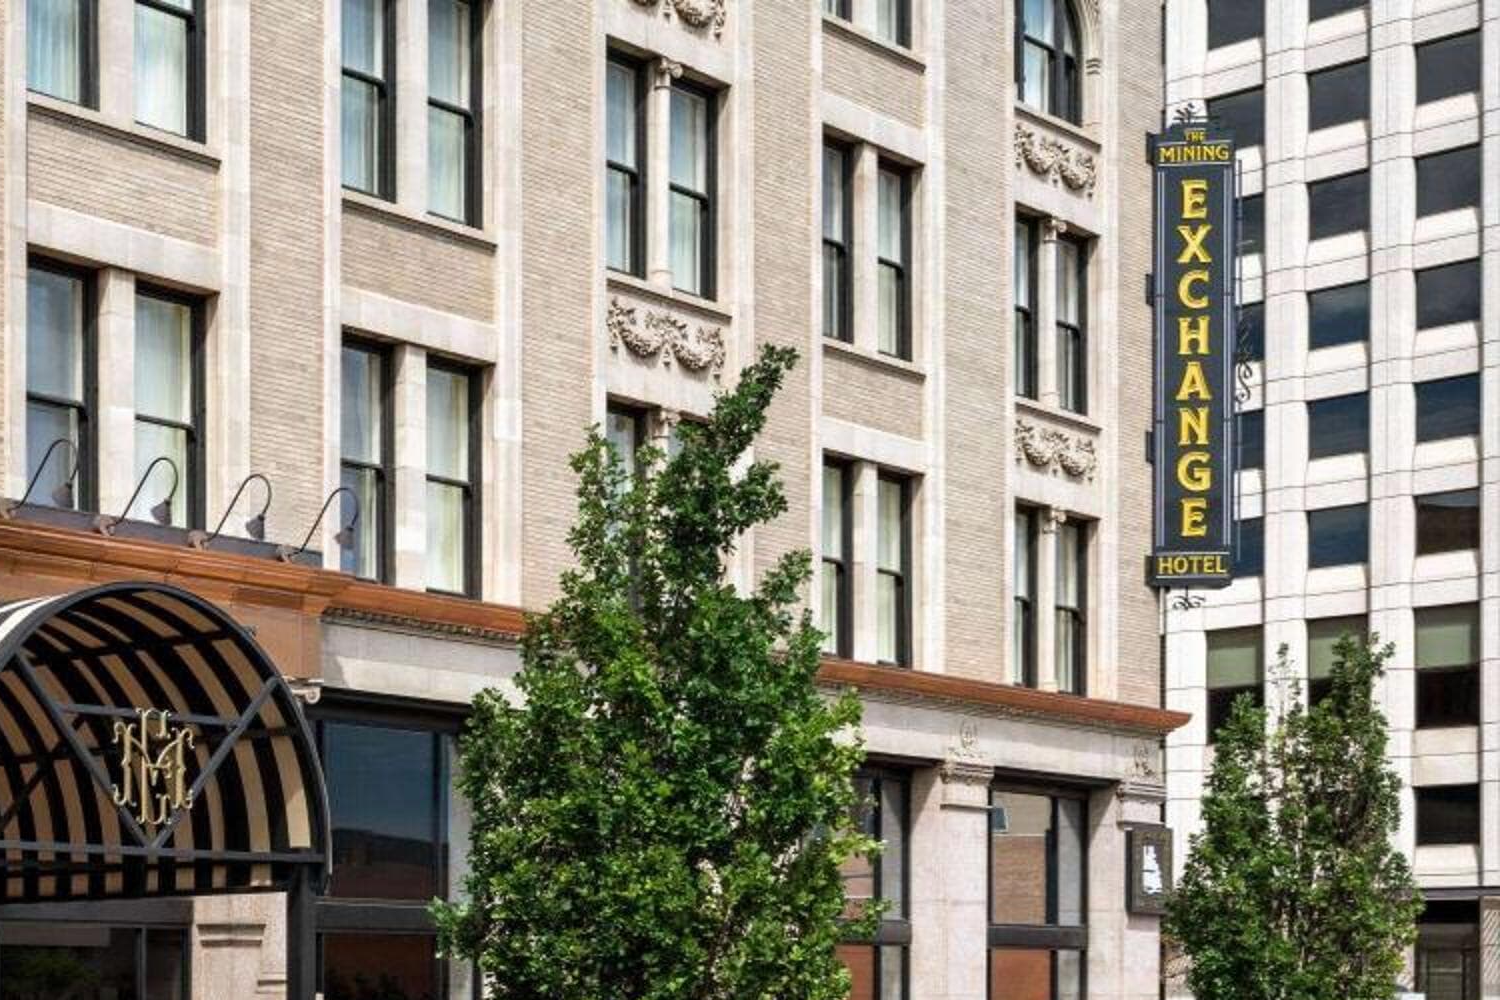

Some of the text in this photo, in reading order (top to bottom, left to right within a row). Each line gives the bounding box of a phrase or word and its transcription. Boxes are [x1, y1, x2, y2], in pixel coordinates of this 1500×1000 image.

[1184, 128, 1206, 143] THE
[1159, 144, 1229, 163] MINING
[1176, 179, 1212, 537] EXCHANGE
[1157, 555, 1226, 574] HOTEL
